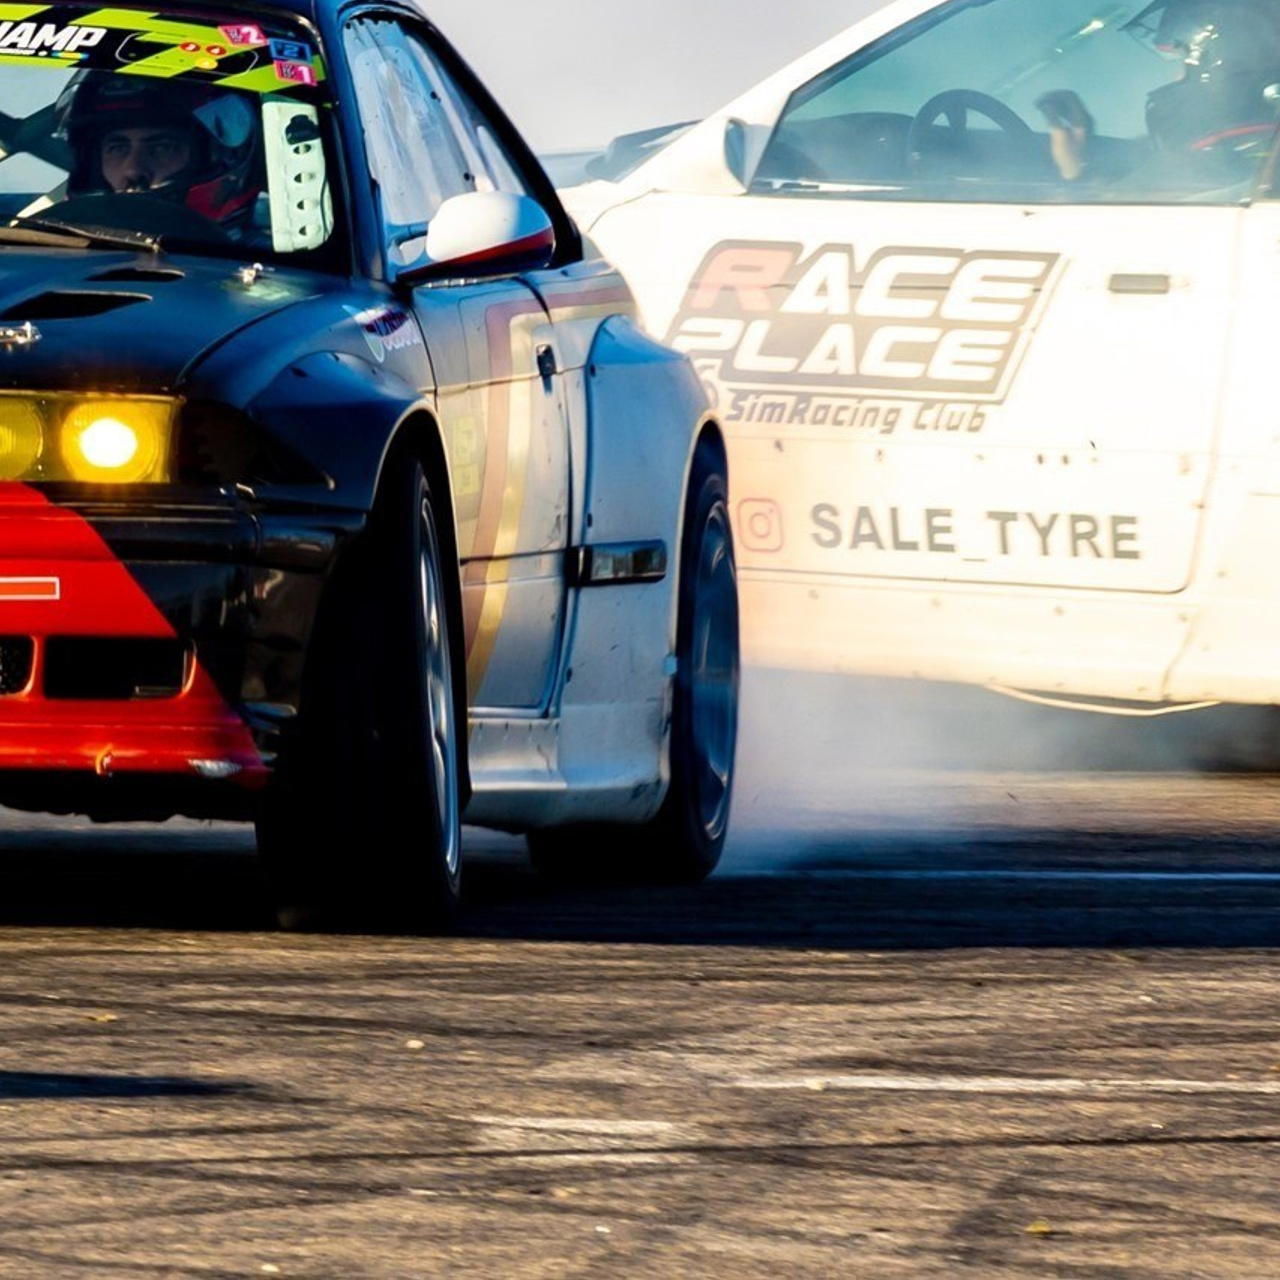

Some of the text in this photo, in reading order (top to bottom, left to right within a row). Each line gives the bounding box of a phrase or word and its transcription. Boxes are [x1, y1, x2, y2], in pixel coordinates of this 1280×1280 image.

[689, 248, 1048, 322] RACE
[671, 317, 1012, 381] PLACE
[726, 389, 986, 434] SimRacing Club
[810, 502, 1141, 562] SALE_TYRE
